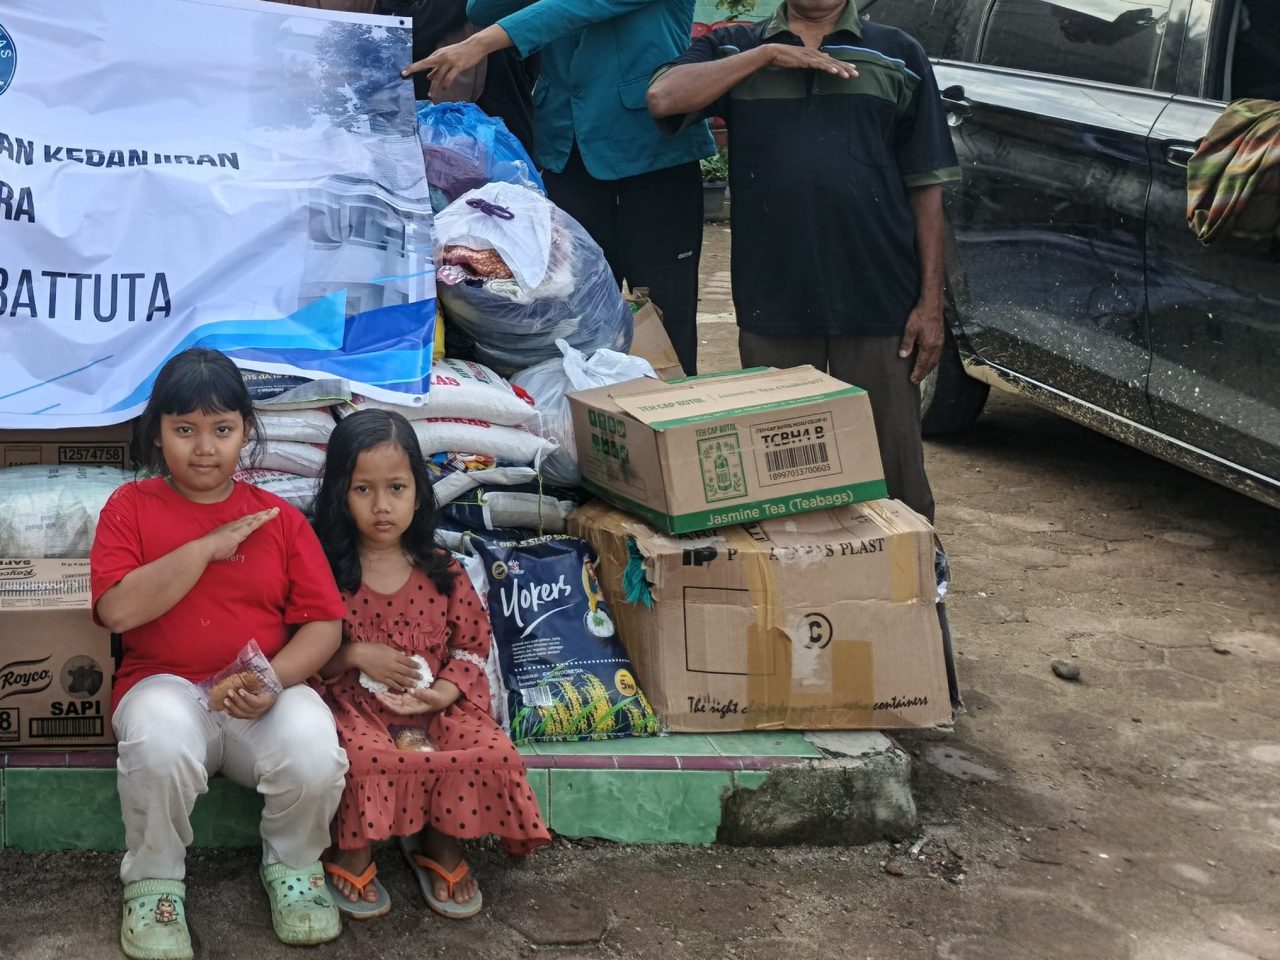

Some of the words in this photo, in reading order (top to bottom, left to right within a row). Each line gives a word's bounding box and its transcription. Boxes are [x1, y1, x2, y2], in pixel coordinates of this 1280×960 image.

[696, 429, 707, 437] TEH
[707, 426, 718, 436] CAP
[719, 423, 737, 434] BOTOL
[61, 448, 120, 461] 12574758
[707, 508, 760, 526] Jasmine
[763, 503, 786, 516] Tea
[789, 490, 854, 513] (Teabags)
[839, 538, 886, 557] PLAST
[500, 574, 572, 628] Yokers
[0, 669, 50, 690] Royco
[50, 700, 101, 717] SAPI
[687, 695, 706, 715] The
[709, 698, 739, 720] right
[873, 695, 929, 712] containers
